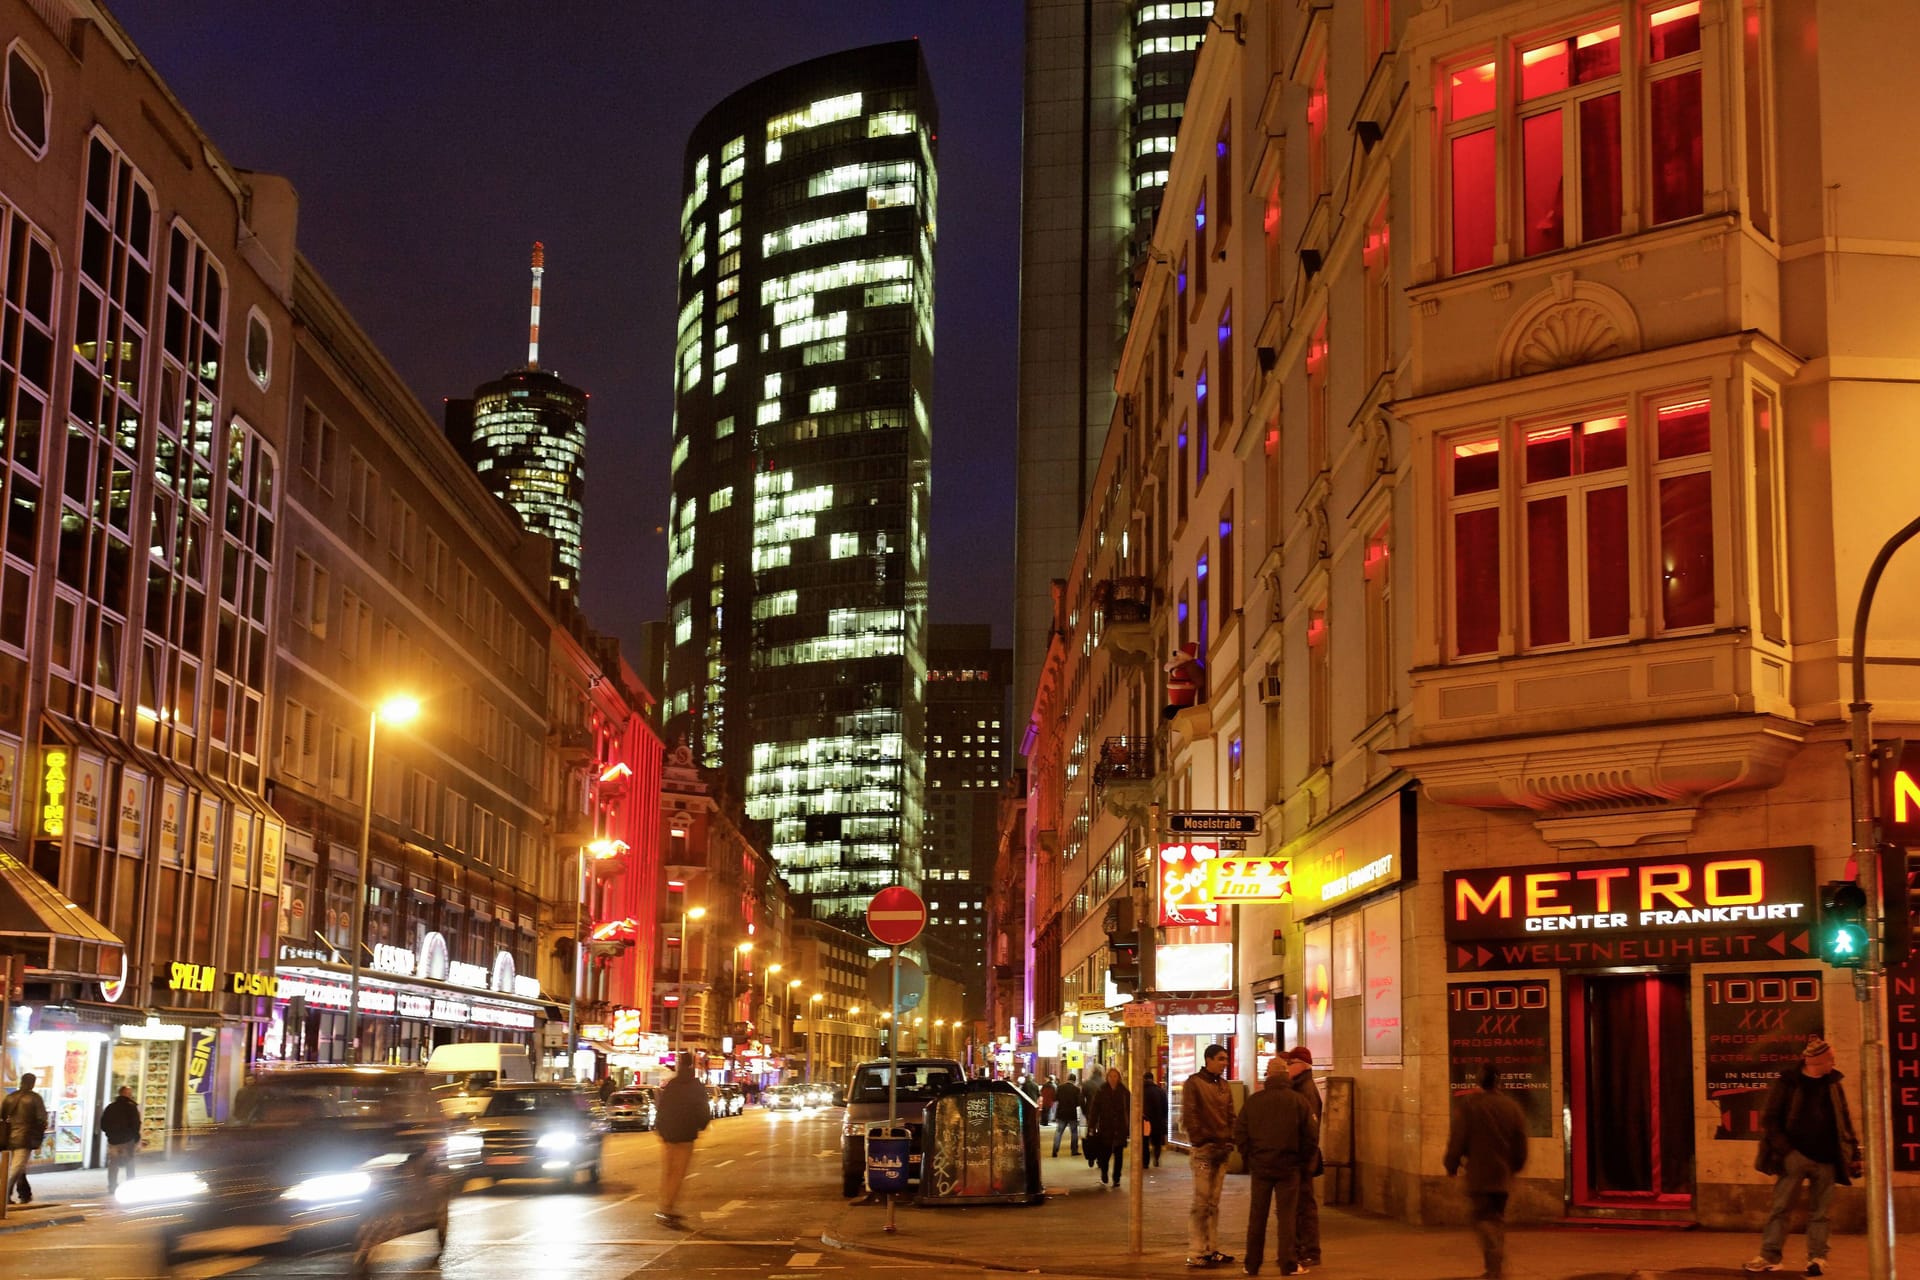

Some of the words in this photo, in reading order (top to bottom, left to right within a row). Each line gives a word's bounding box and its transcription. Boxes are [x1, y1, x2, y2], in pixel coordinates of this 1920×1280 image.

[1183, 817, 1241, 829] Moselstraße
[1221, 861, 1290, 877] SEX
[1221, 881, 1261, 895] Inn
[1455, 859, 1764, 921] METRO
[1525, 912, 1628, 932] CENTER
[1639, 903, 1804, 926] FRANKFURT
[1502, 935, 1757, 965] WELTNEUHEIT
[233, 972, 279, 998] CASINO
[1707, 977, 1820, 1005] 1000
[1451, 985, 1548, 1011] 1000
[1476, 1015, 1521, 1034] XXX
[1738, 1008, 1791, 1030] XXX
[1453, 1038, 1545, 1047] PROGRAMME
[1710, 1054, 1753, 1062] EXTRA
[1895, 977, 1920, 1162] NEUHEIT
